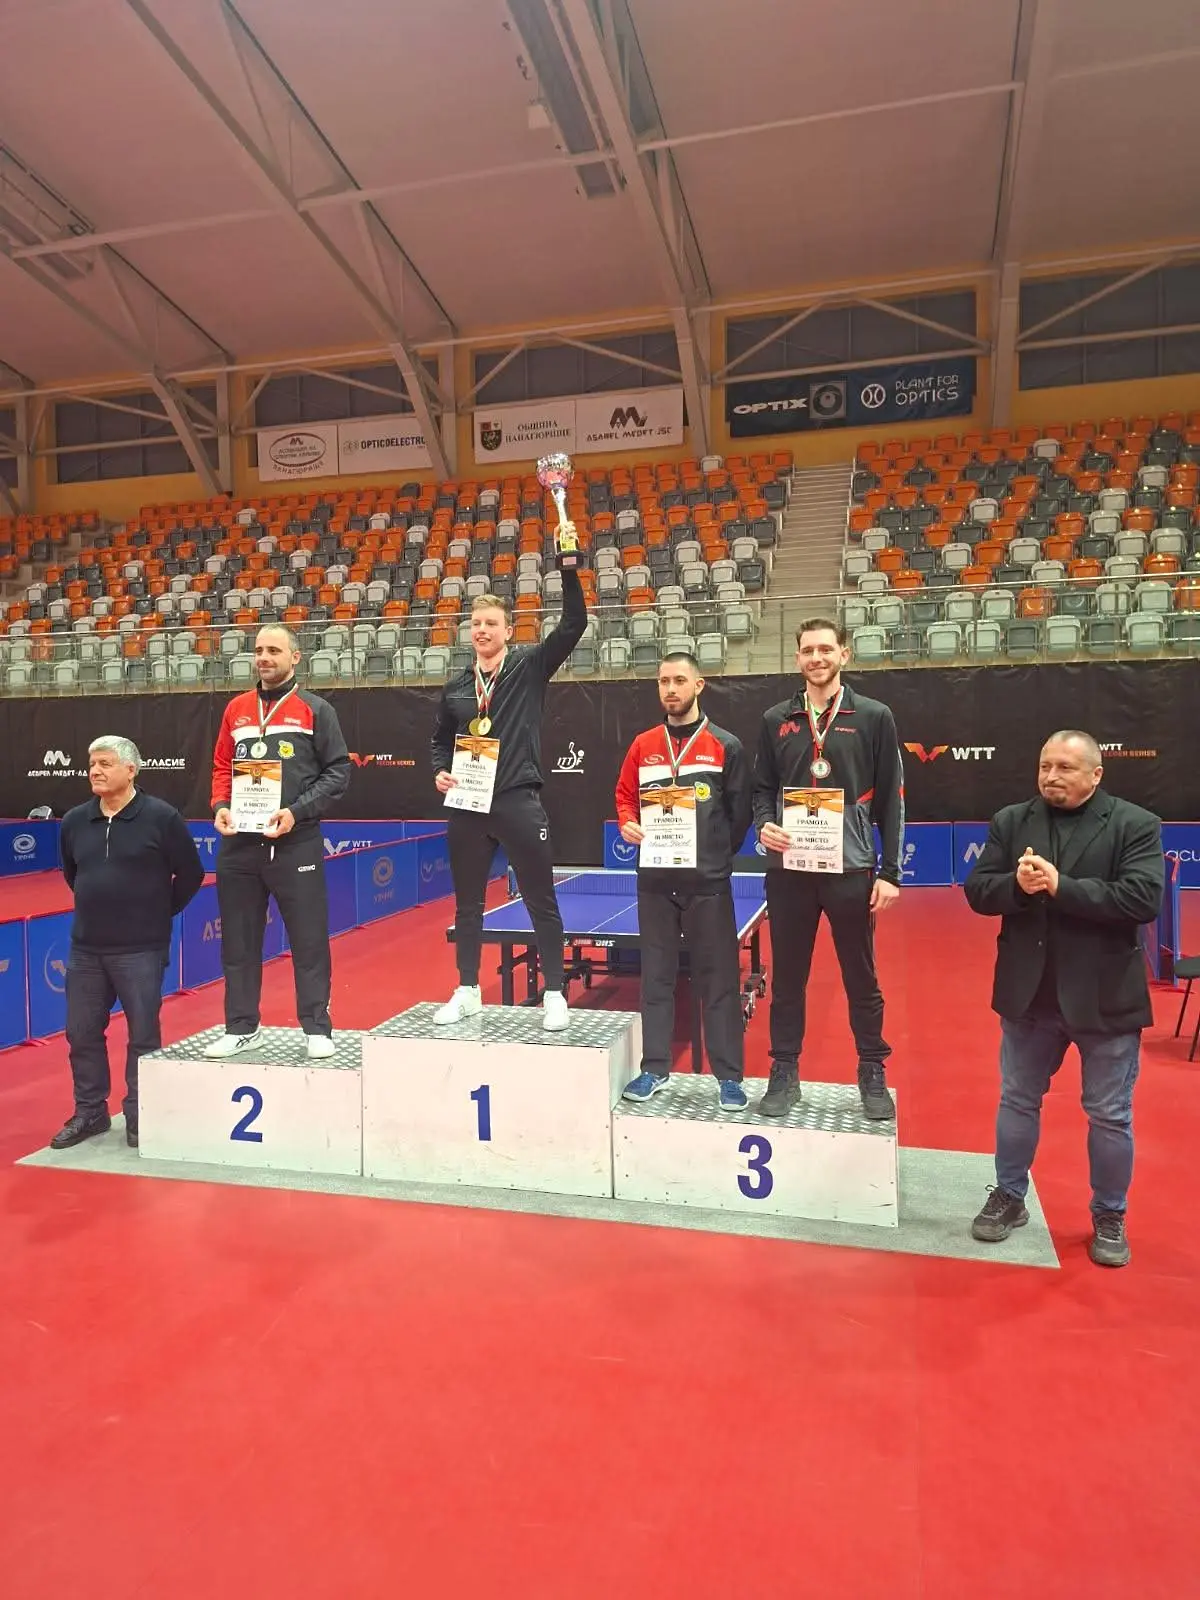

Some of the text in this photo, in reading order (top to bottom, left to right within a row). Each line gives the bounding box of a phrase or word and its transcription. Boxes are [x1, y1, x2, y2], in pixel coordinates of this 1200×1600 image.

[896, 375, 959, 390] PLANT FOR
[895, 386, 959, 405] OPTICS
[733, 398, 808, 415] OPTIX
[952, 747, 996, 760] WTT
[140, 758, 186, 767] ЪГЛАСИЕ
[352, 840, 373, 848] WTT
[229, 1086, 265, 1142] 2
[470, 1084, 492, 1142] 1
[737, 1135, 774, 1200] 3
